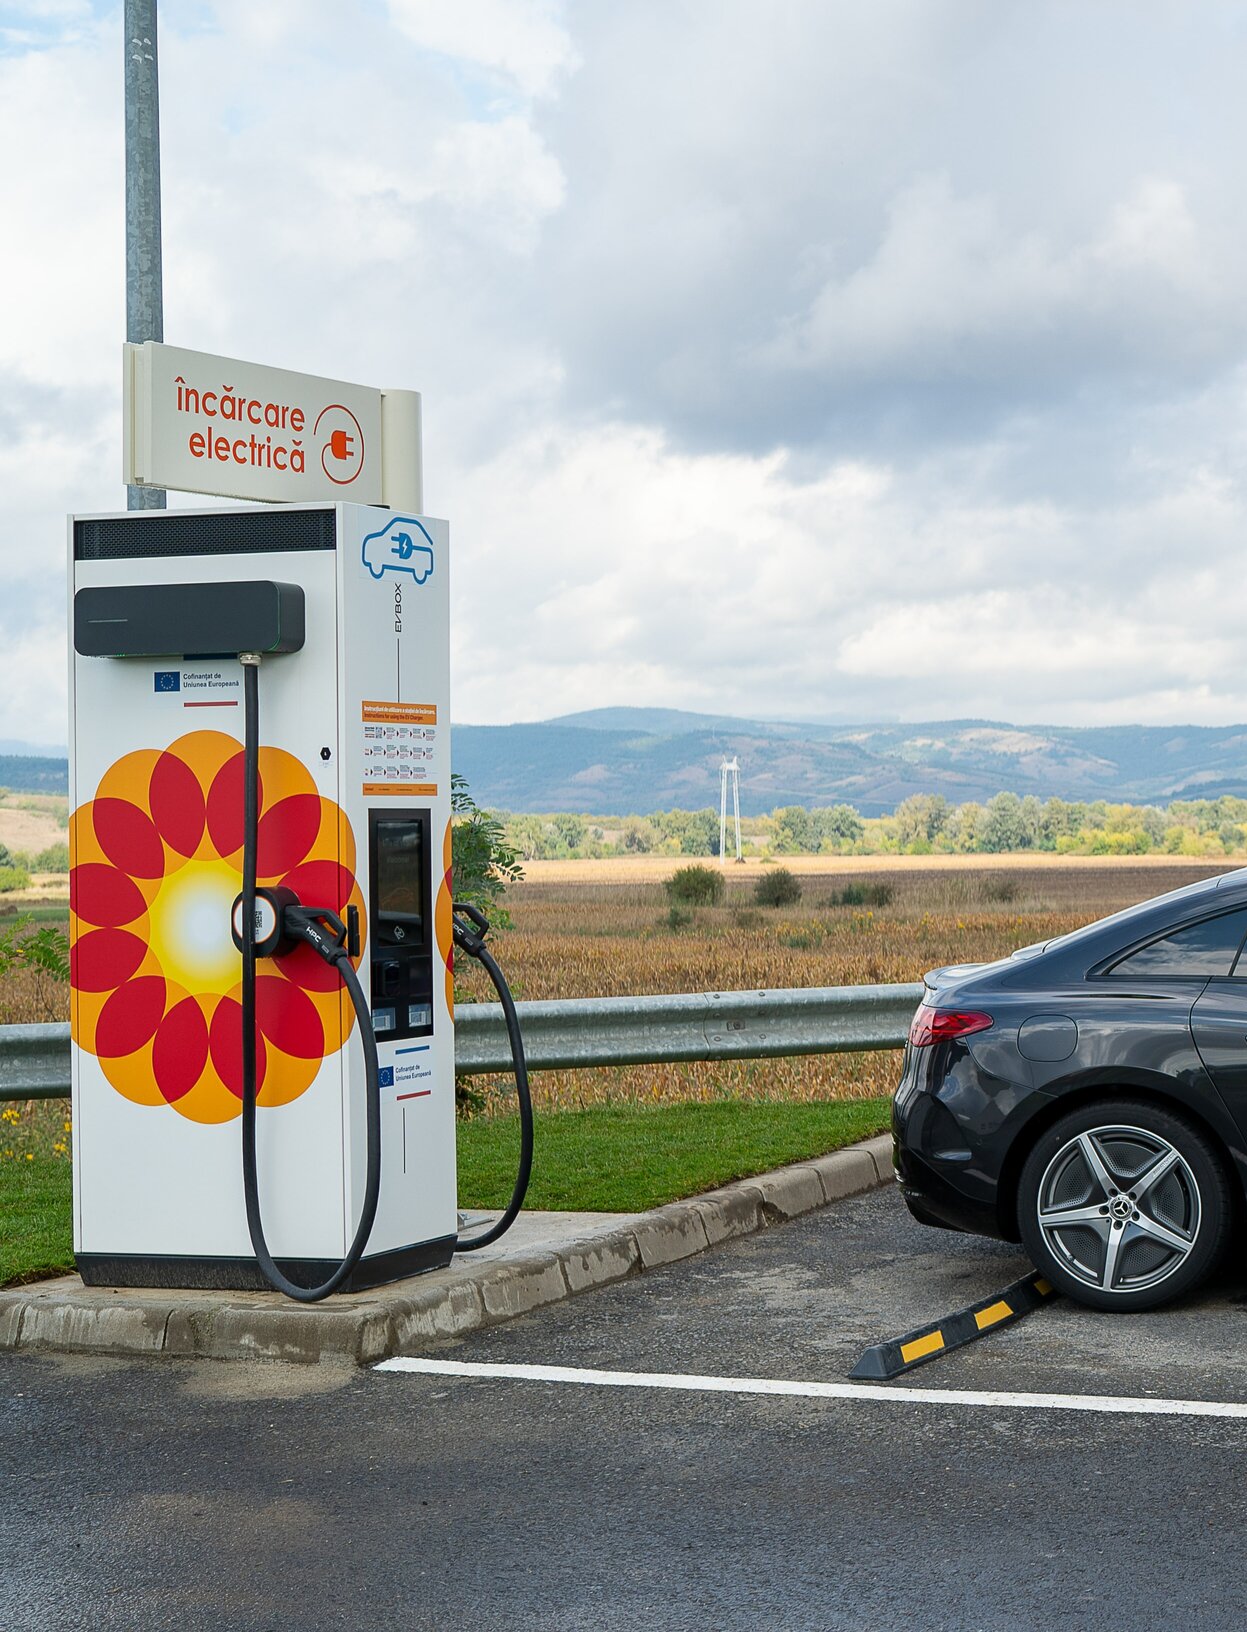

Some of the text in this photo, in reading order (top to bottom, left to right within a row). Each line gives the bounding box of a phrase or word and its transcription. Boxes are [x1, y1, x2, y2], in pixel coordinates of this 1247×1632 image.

[174, 376, 305, 432] încărcare
[189, 426, 305, 473] electrică
[394, 582, 402, 633] EVBOX
[306, 926, 322, 943] HPC
[412, 1070, 431, 1078] Europeană
